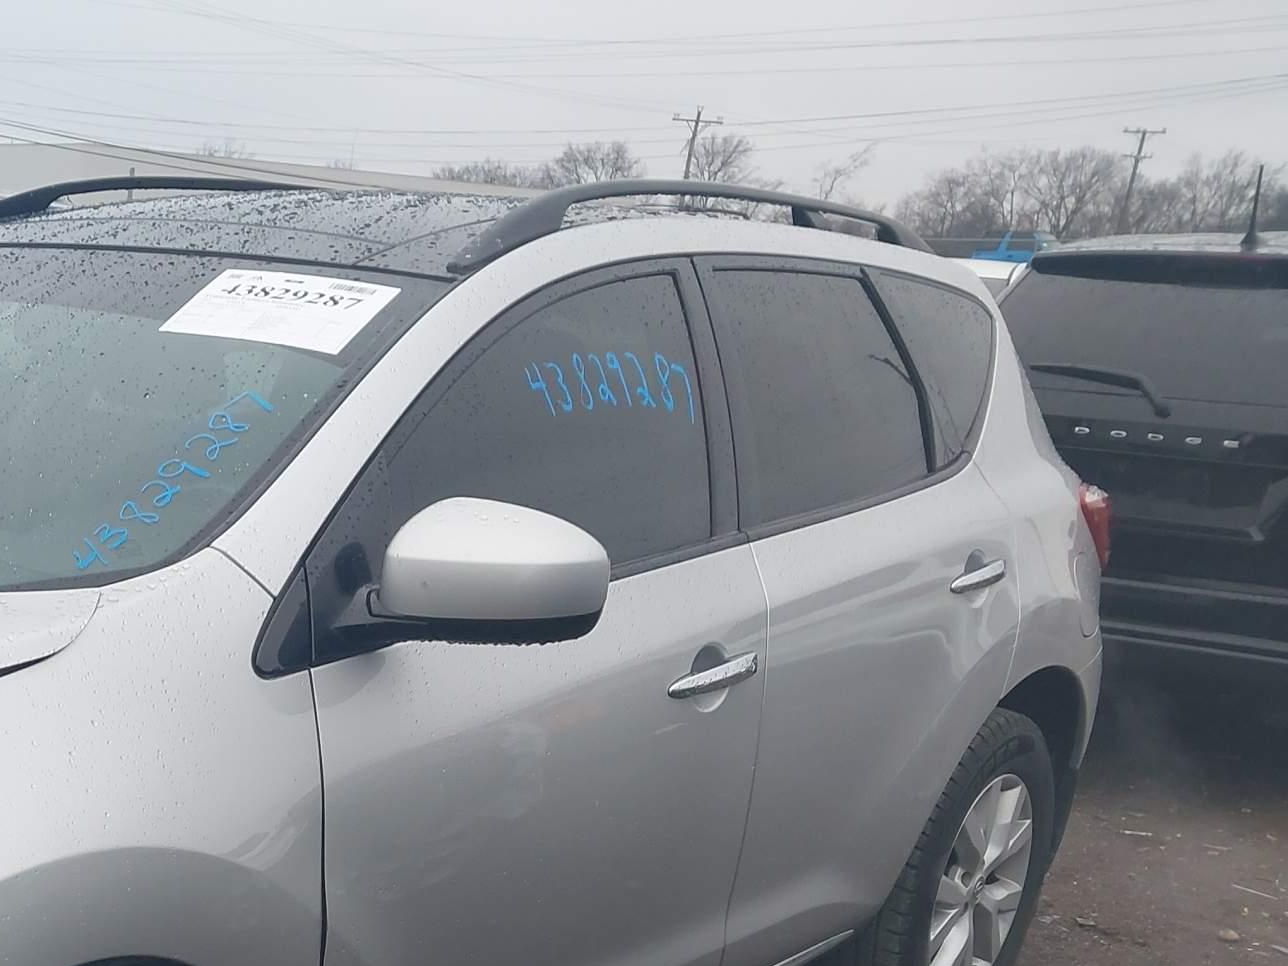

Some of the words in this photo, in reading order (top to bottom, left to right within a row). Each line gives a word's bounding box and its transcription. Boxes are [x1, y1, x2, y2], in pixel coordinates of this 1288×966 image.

[221, 282, 365, 310] 43829287
[524, 350, 695, 425] 43829287
[1074, 426, 1240, 448] DODGE
[72, 389, 275, 570] 43829287
